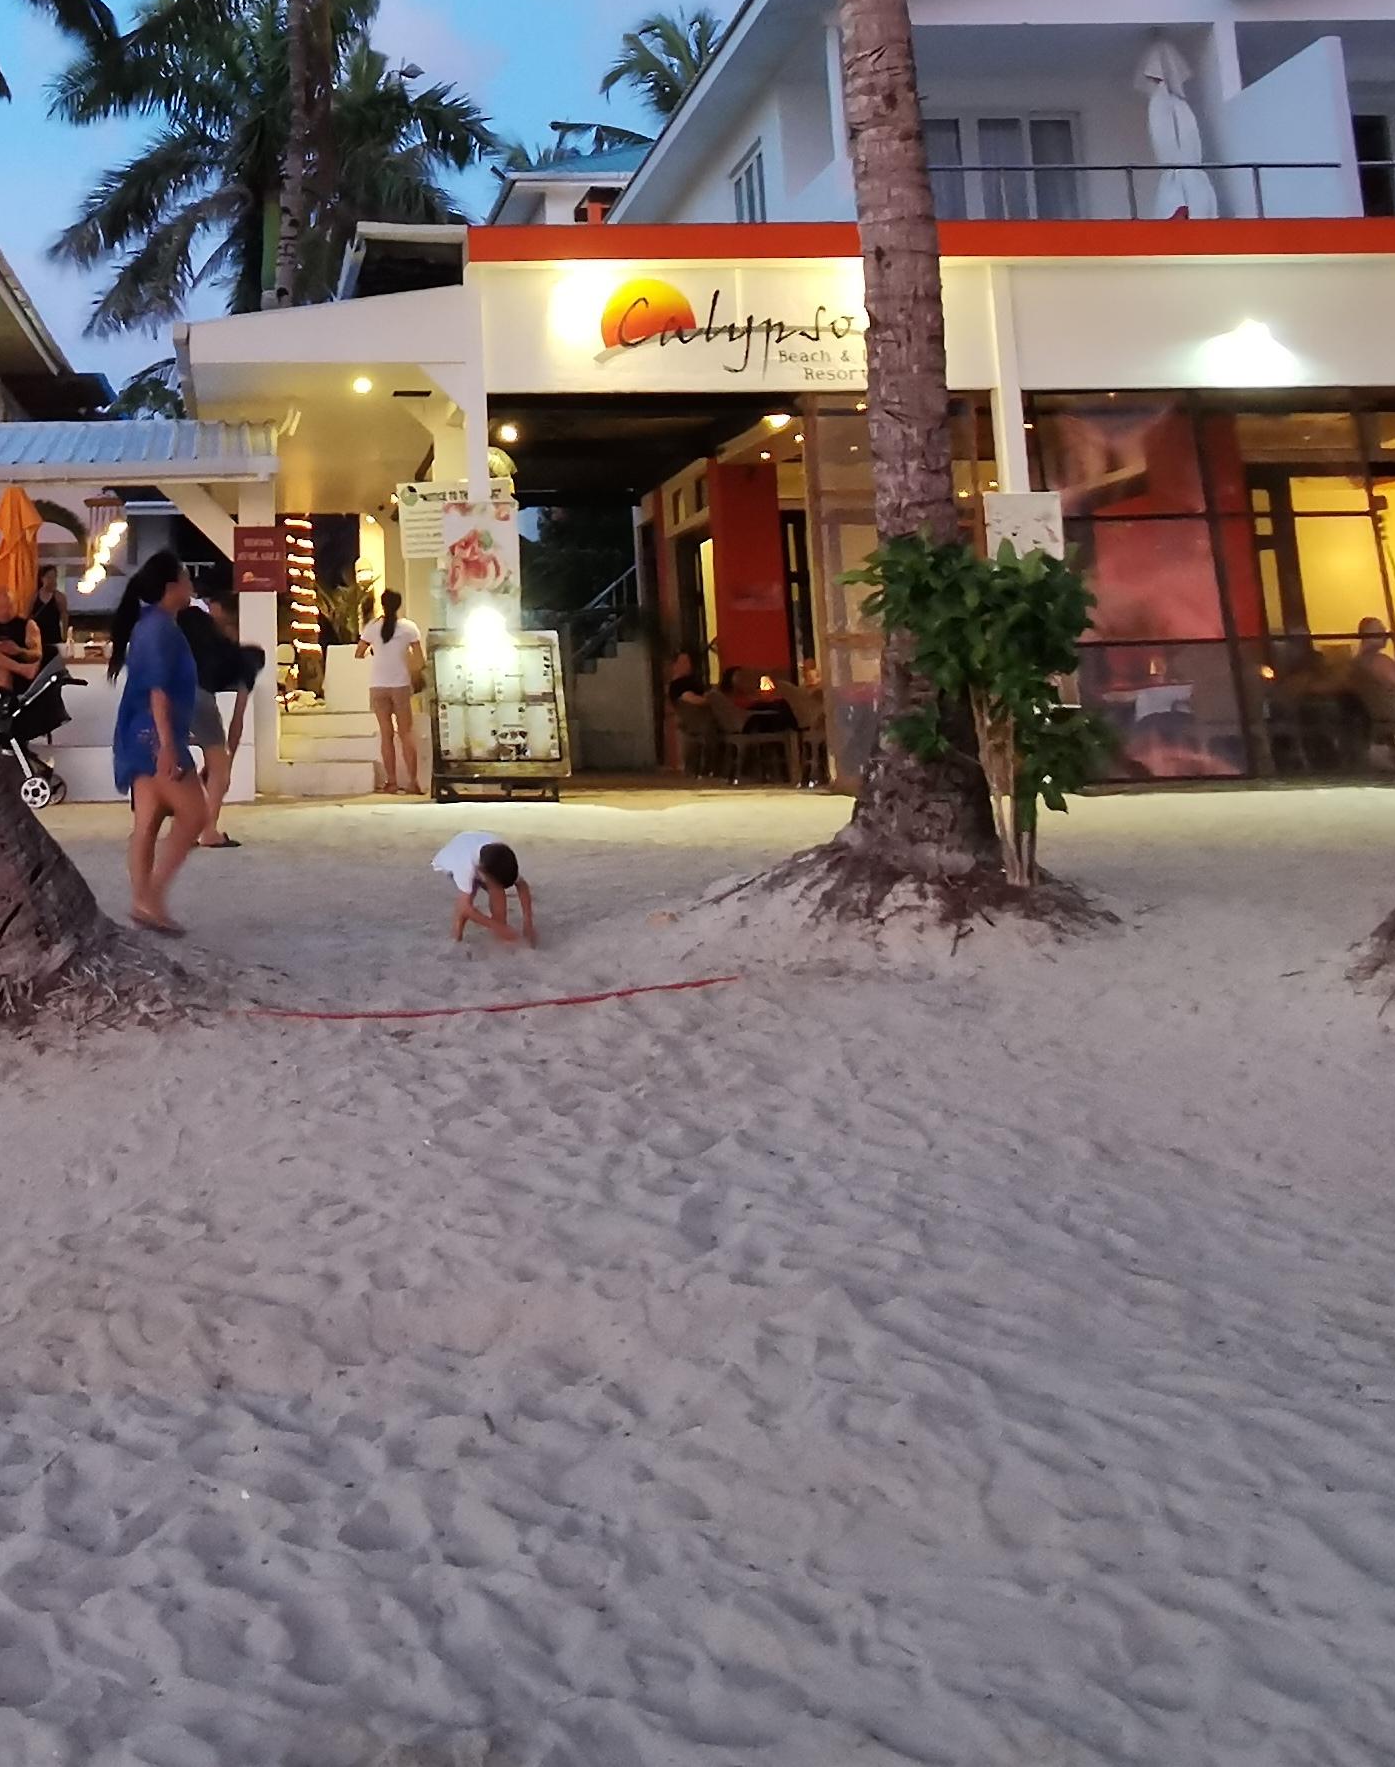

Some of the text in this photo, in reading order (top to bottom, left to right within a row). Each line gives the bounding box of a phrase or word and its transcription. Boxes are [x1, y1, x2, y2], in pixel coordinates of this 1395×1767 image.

[618, 289, 854, 381] Calypso
[779, 350, 831, 363] Beach
[840, 350, 850, 362] &
